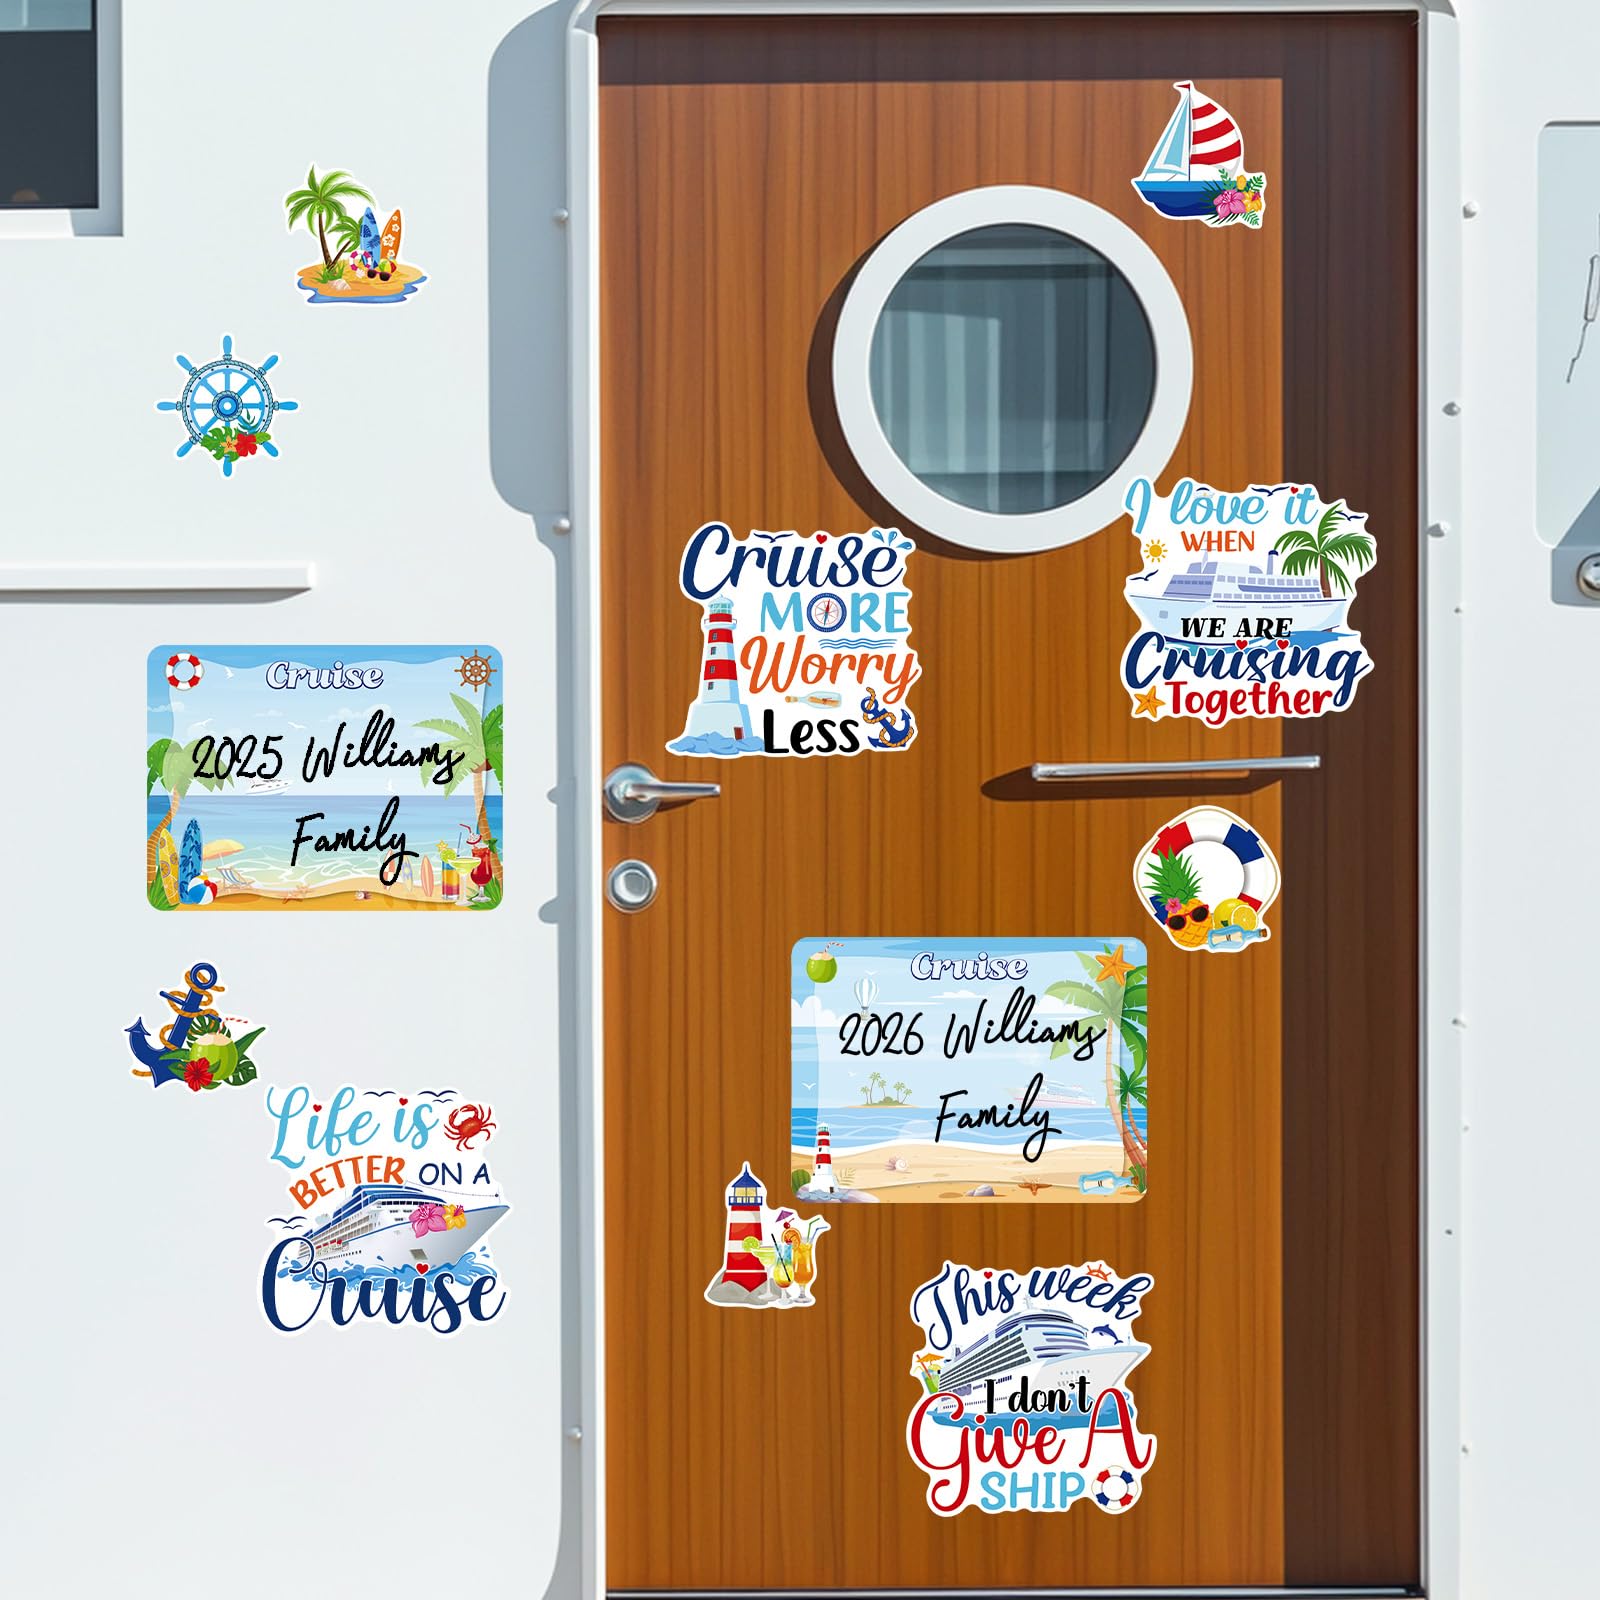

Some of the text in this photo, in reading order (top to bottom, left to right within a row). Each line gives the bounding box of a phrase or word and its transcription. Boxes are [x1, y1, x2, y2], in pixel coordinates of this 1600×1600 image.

[1125, 478, 1319, 535] I love it
[682, 524, 904, 600] Cruise
[1180, 530, 1255, 552] WHEN
[760, 591, 910, 633] MORE
[1181, 617, 1293, 638] WE ARE
[266, 660, 384, 690] Cruise
[740, 634, 919, 705] Worry
[1125, 631, 1370, 707] Cruising
[763, 708, 860, 754] Less
[1164, 681, 1333, 725] Together
[192, 709, 466, 785] 2025 Williams
[290, 796, 420, 886] Family
[910, 951, 1028, 980] Cruise
[839, 985, 1108, 1061] 2026 Williams
[266, 1086, 440, 1169] Life is
[935, 1072, 1063, 1163] Family
[289, 1155, 491, 1210] BETTER ON A
[262, 1236, 507, 1334] Cruise
[913, 1263, 1151, 1351] This week
[984, 1375, 1094, 1415] I don't
[911, 1387, 1153, 1512] Give A
[980, 1471, 1086, 1511] SHIP
